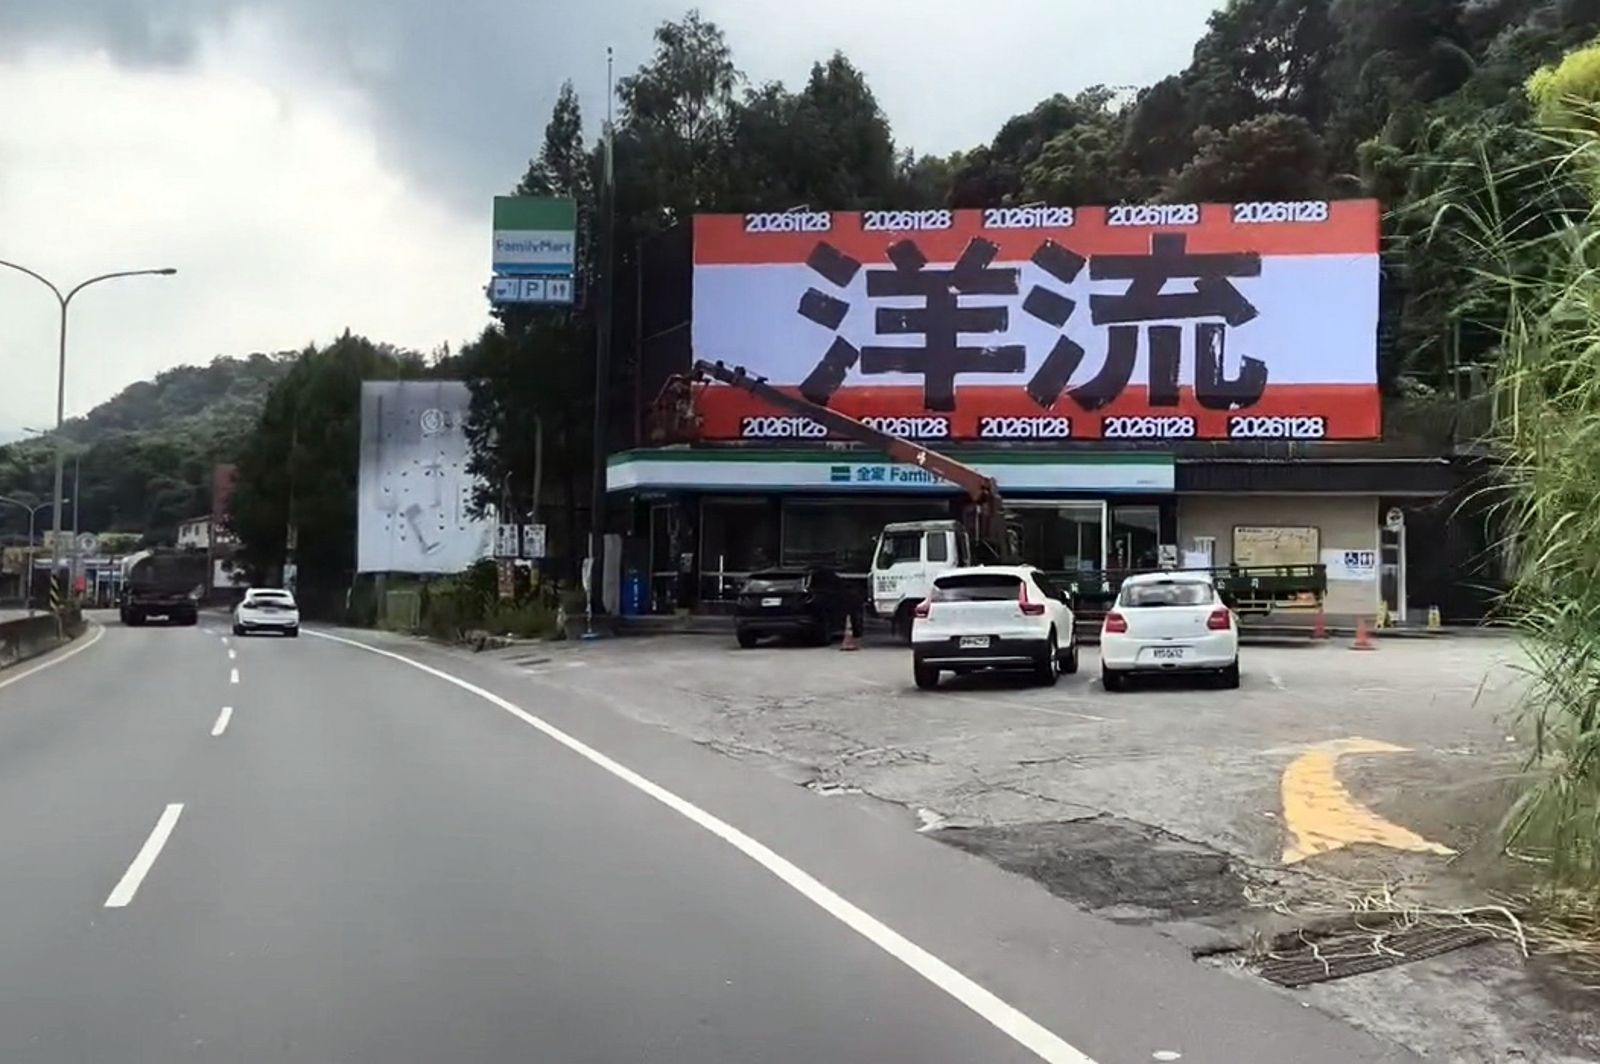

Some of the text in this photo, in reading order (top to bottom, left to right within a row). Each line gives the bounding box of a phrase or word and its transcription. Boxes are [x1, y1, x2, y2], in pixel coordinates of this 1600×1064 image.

[745, 201, 1328, 232] 20261128 20261128 20261128 20261128 20261128
[496, 239, 571, 253] FamilyMart
[798, 233, 1269, 411] 洋流
[981, 416, 1070, 438] 20261128
[1104, 416, 1195, 438] 20261128
[1230, 416, 1325, 438] 20261128
[857, 466, 945, 484] 全家 Family
